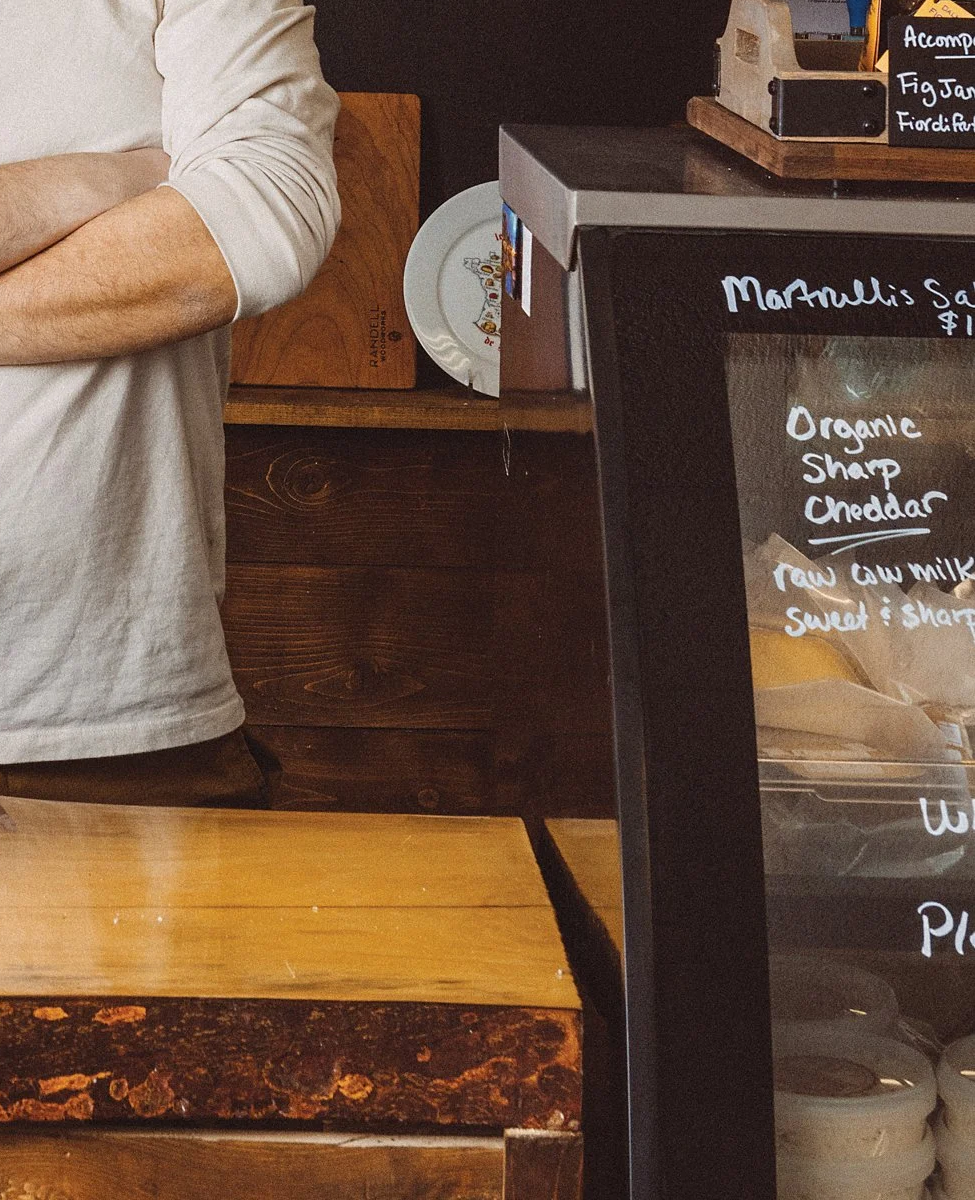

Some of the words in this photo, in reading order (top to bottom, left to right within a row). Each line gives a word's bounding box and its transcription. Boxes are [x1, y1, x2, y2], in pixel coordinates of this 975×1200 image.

[942, 5, 959, 17] DAL
[903, 25, 975, 54] Accomp
[896, 71, 937, 107] Fig
[370, 305, 380, 368] RANDELL
[786, 405, 922, 454] Organic
[801, 453, 901, 490] Sharp
[805, 491, 948, 524] Cheddar
[773, 562, 836, 592] raw
[907, 556, 975, 583] milk
[917, 901, 975, 958] Pl
